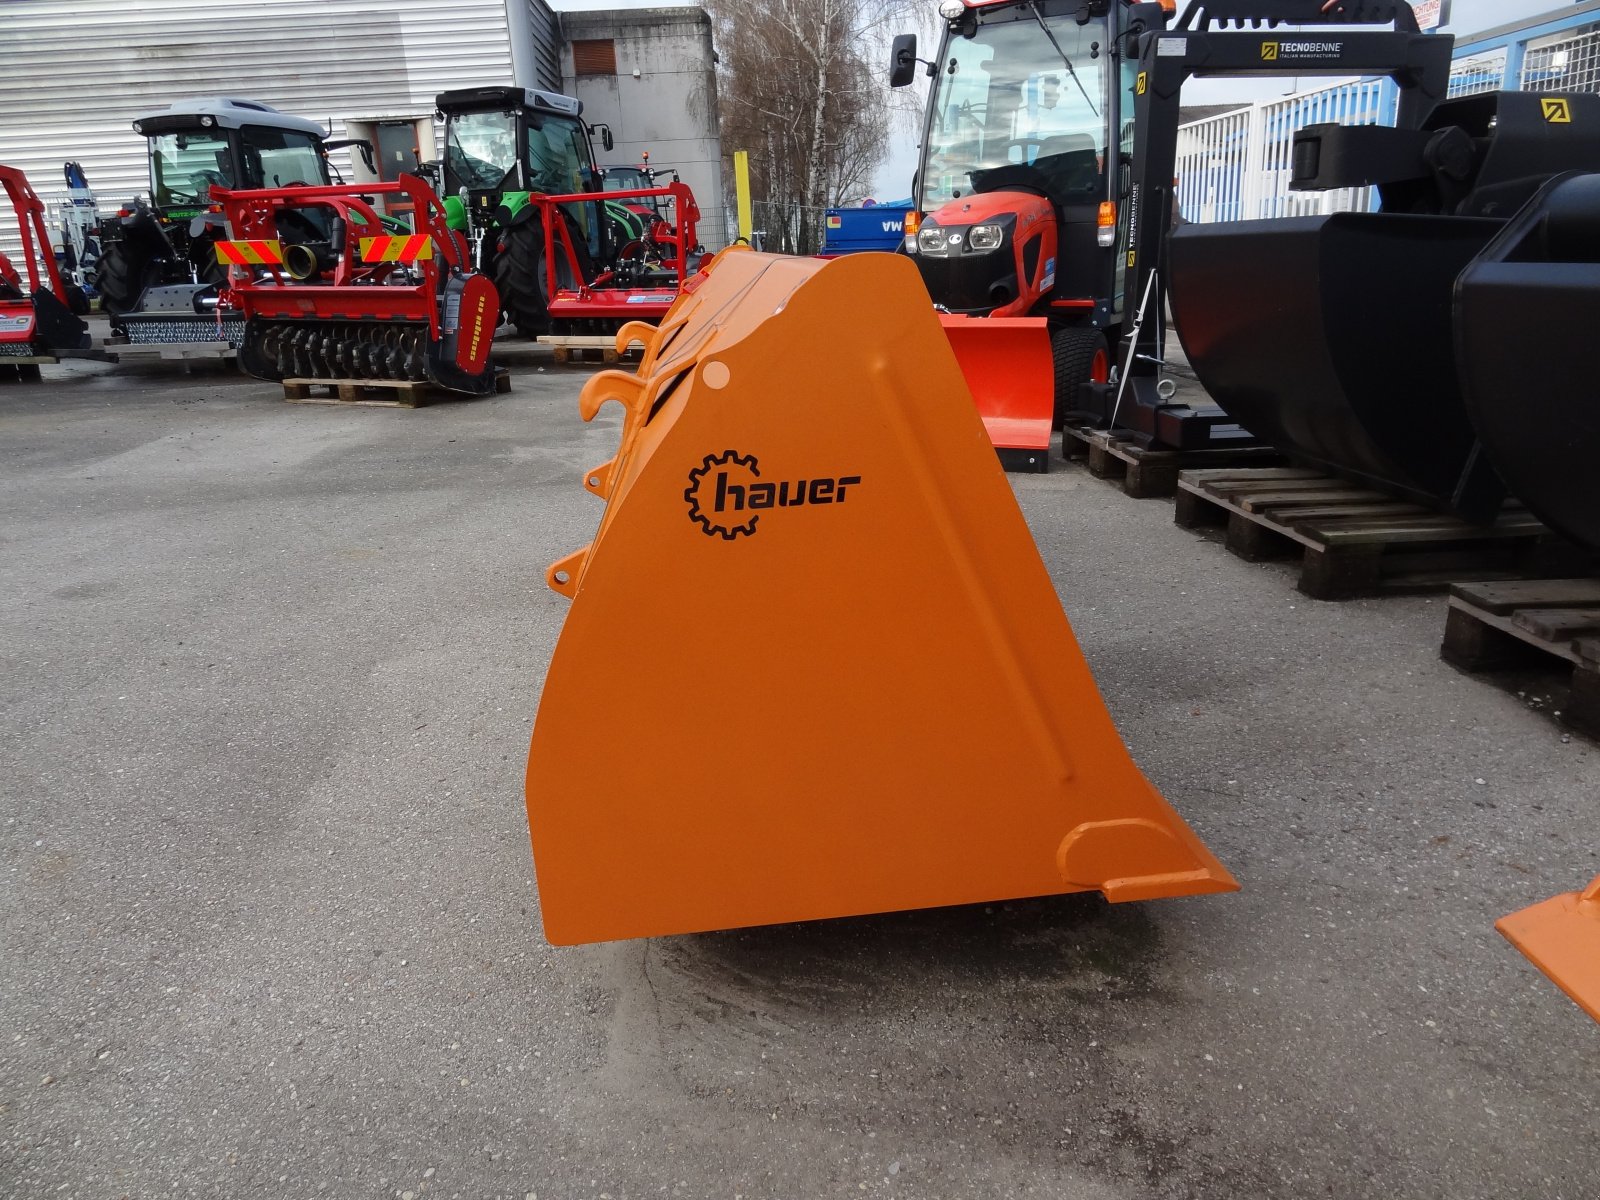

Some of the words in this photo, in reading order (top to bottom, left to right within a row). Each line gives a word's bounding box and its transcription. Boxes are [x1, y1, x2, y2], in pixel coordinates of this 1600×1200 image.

[1280, 42, 1341, 52] TECNOBENNE
[1129, 184, 1137, 248] TECNOBENNE
[714, 472, 861, 512] hauer
